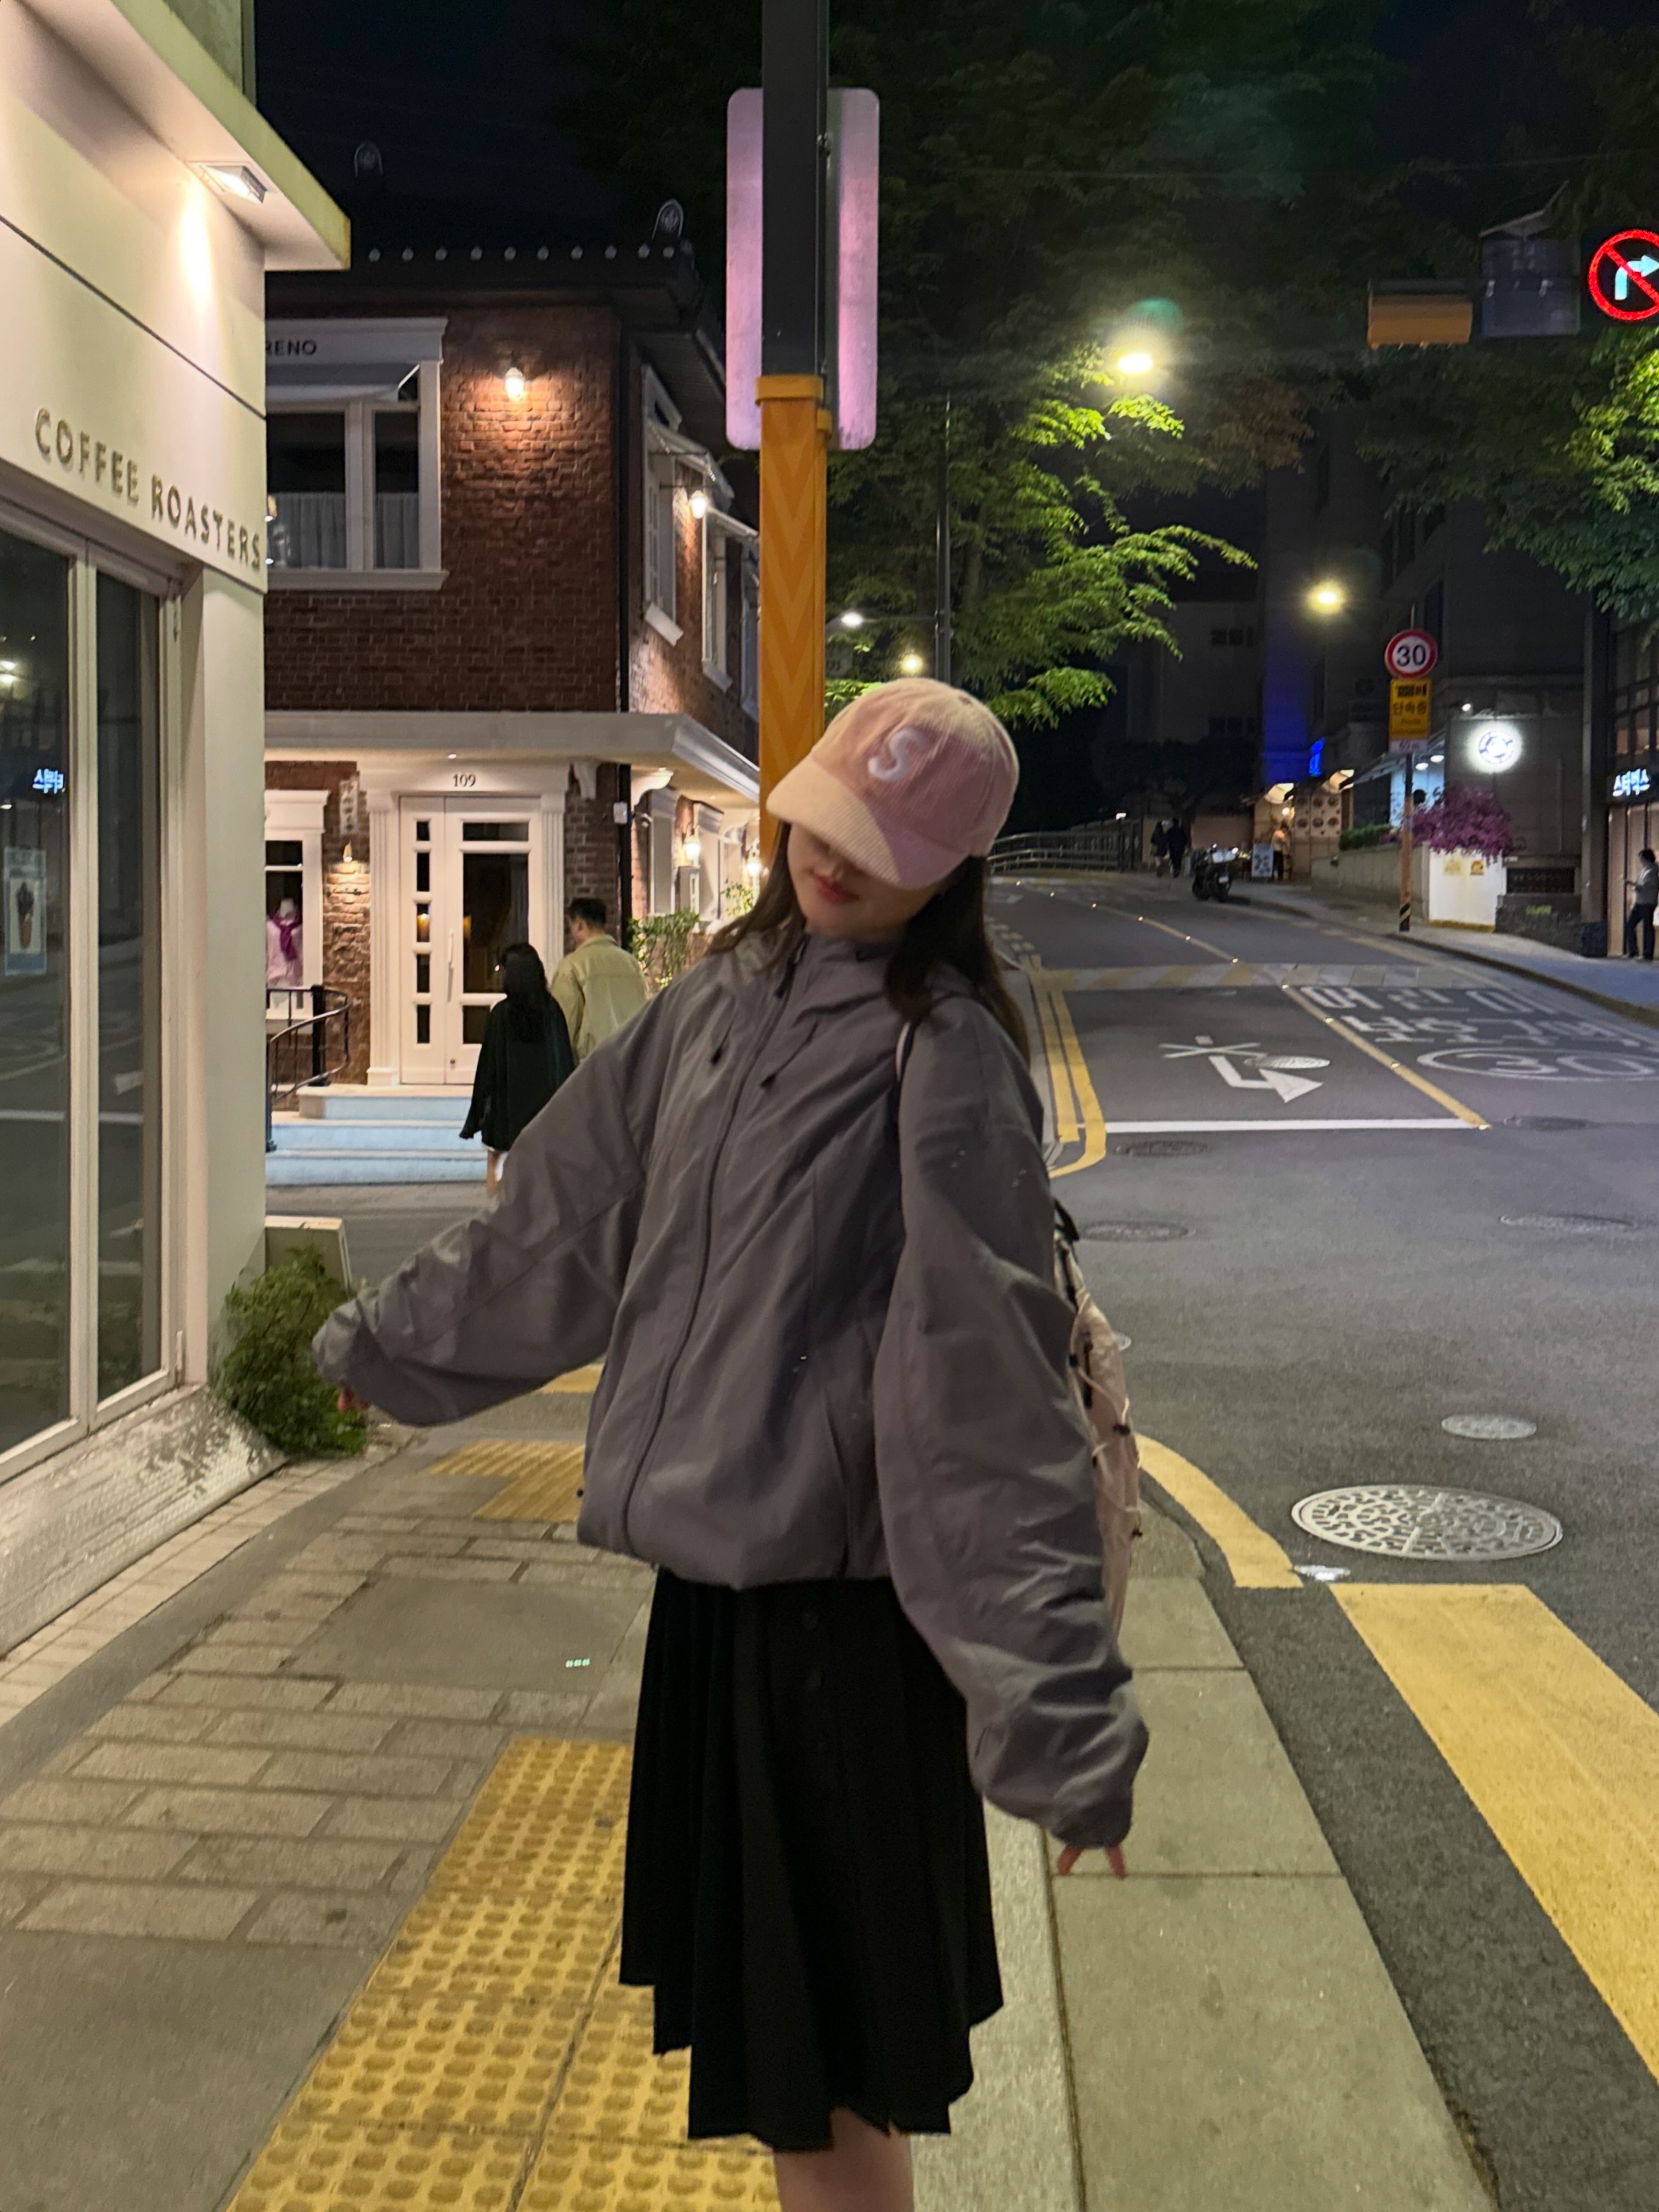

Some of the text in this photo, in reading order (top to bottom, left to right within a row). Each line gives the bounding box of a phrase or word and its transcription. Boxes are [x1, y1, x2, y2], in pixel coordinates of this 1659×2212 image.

[35, 408, 261, 571] COFFEE ROASTERS
[1396, 644, 1426, 667] 30
[867, 727, 928, 782] S
[453, 774, 476, 787] 109
[1612, 768, 1650, 797] 스타벅스
[1455, 1053, 1655, 1075] 30
